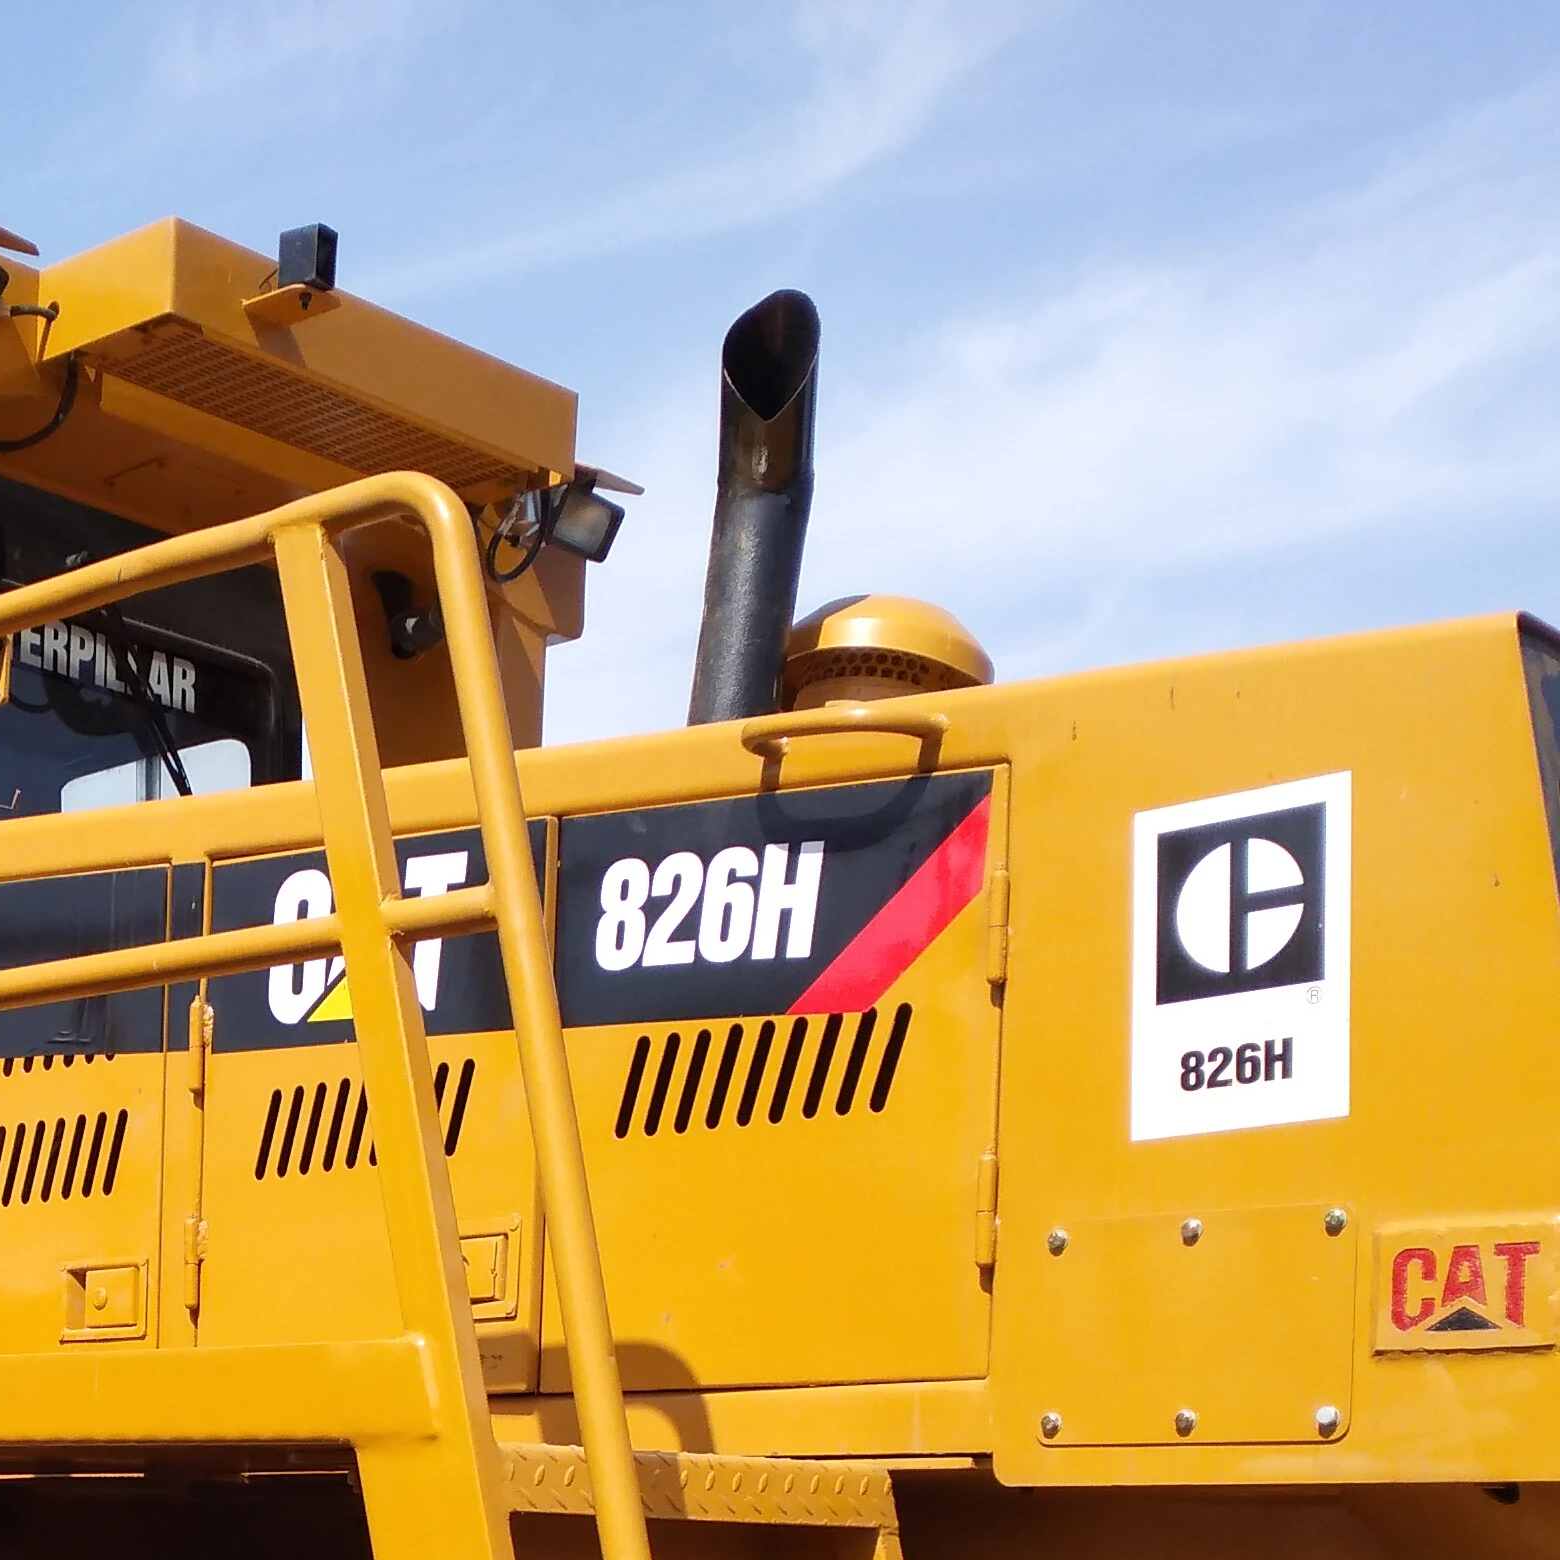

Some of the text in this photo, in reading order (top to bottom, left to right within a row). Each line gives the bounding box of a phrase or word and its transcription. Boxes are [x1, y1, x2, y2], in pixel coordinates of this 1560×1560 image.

[595, 840, 825, 972] 826H
[1180, 1036, 1293, 1092] 826H
[1391, 1241, 1540, 1331] CAT
